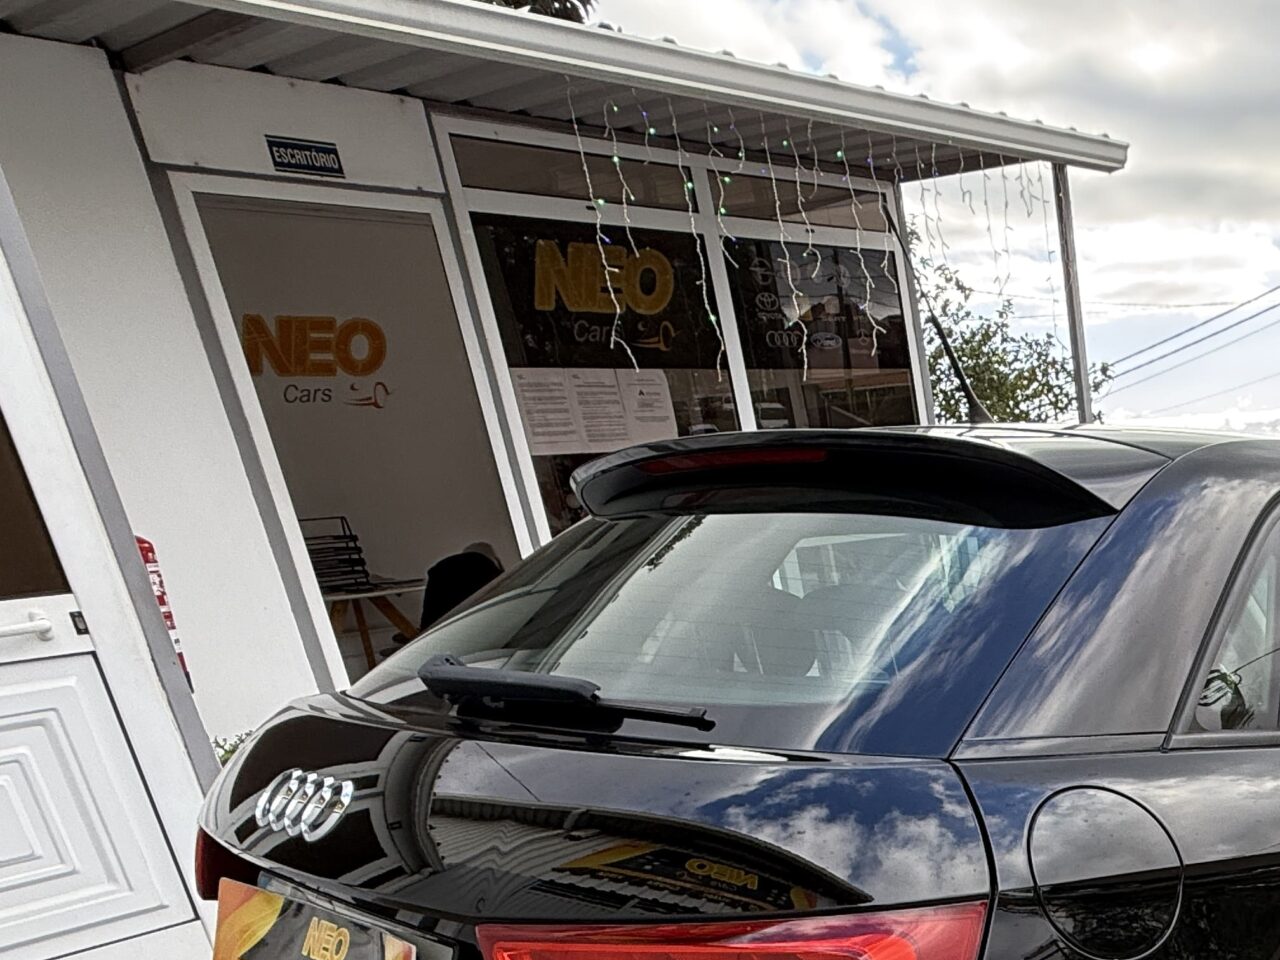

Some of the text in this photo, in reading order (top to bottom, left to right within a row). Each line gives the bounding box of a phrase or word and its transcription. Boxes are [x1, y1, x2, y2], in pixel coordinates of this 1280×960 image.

[272, 147, 339, 169] ESCRITÓRIO
[535, 239, 675, 315] NEO
[243, 314, 387, 377] NEO
[283, 384, 332, 403] Cars
